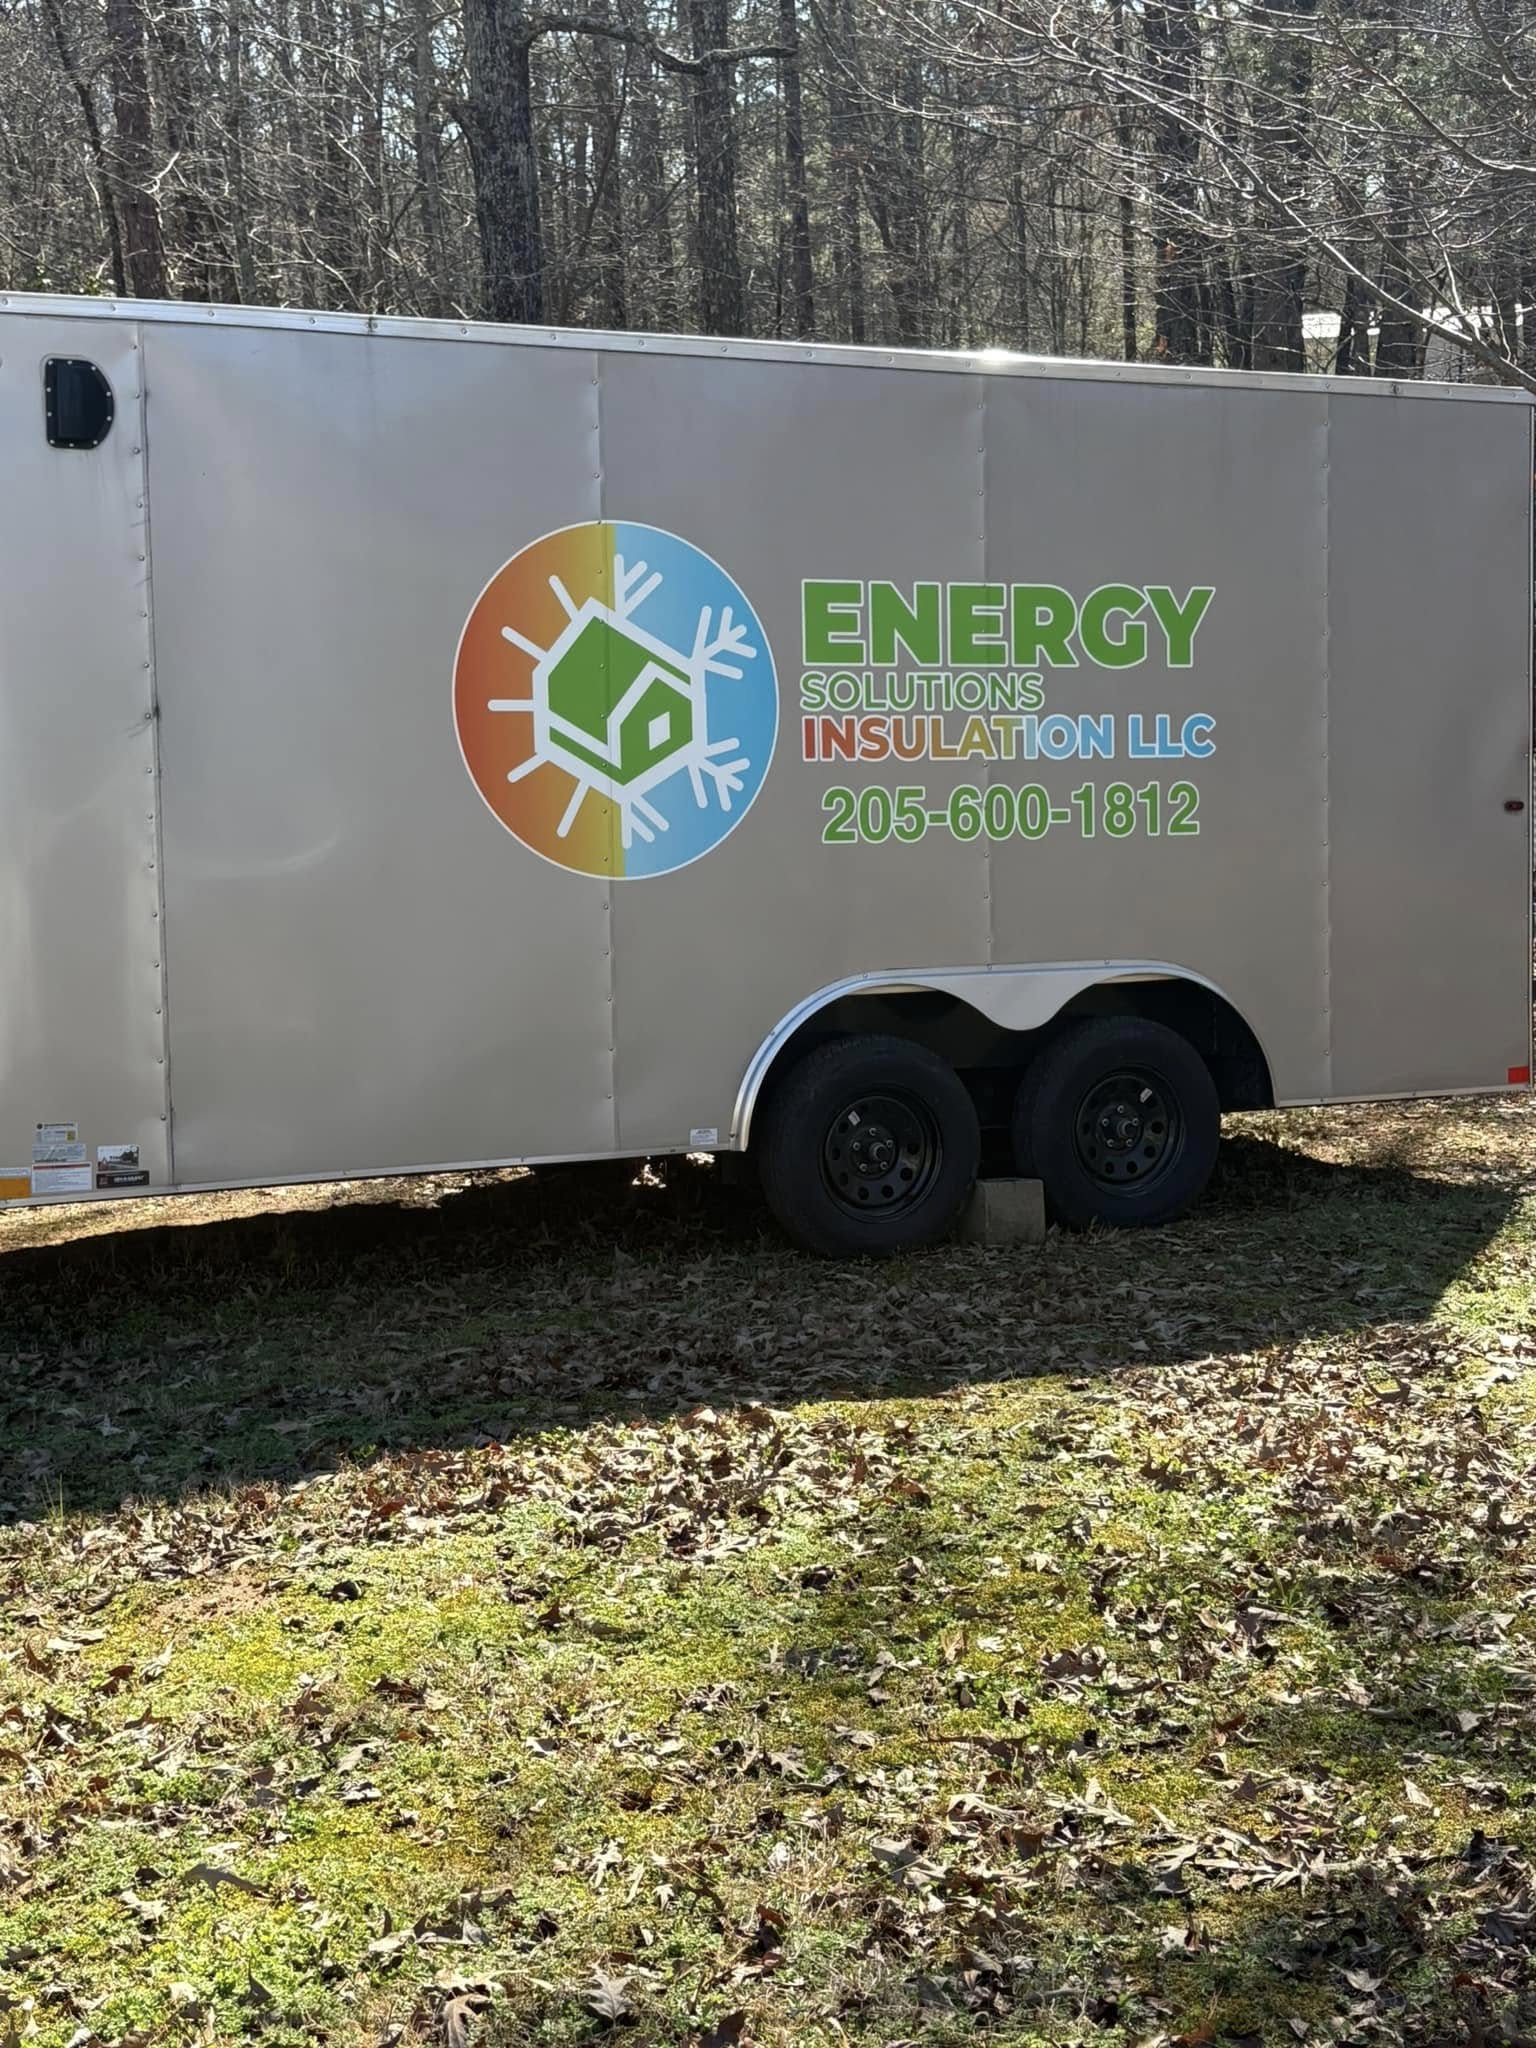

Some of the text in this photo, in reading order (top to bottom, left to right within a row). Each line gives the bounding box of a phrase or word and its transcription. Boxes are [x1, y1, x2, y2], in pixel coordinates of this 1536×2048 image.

[801, 579, 1216, 669] ENERGY
[800, 671, 1045, 711] SOLUTIONS
[802, 713, 1217, 762] INSULATION LLC
[821, 781, 1200, 844] 205-600-1812
